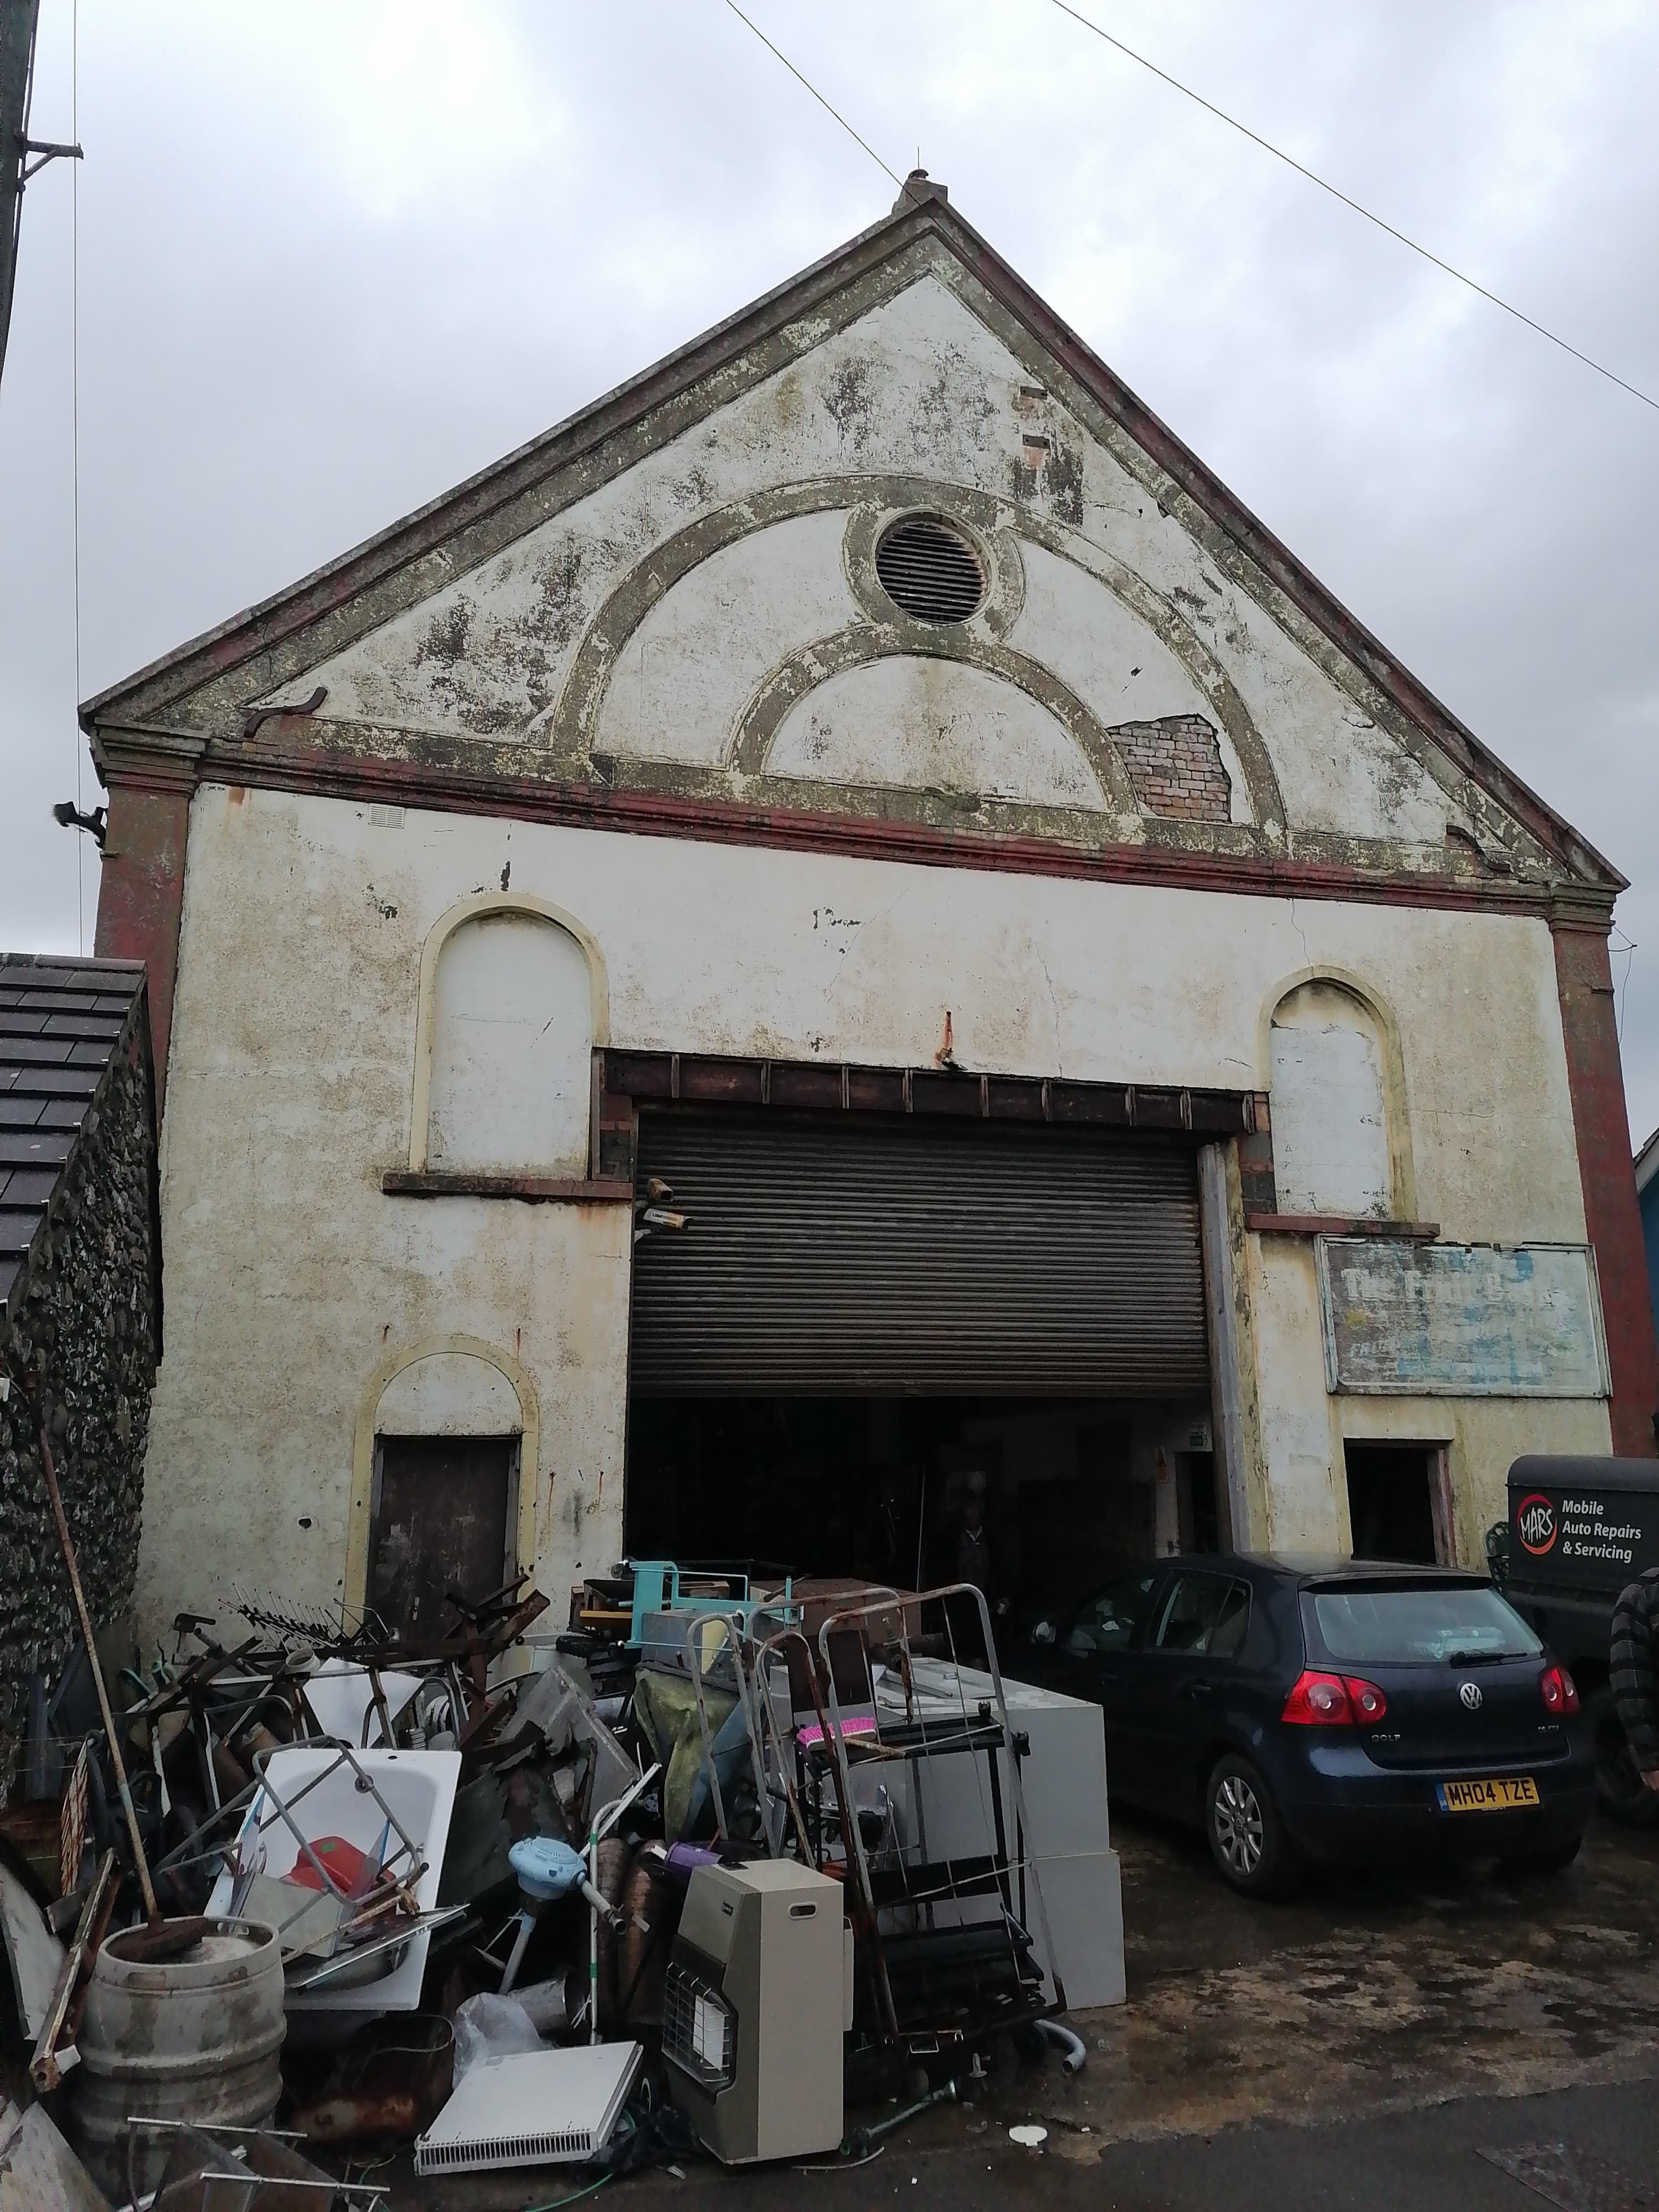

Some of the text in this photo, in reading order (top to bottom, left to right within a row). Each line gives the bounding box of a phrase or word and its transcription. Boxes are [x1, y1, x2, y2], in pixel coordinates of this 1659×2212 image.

[1562, 1500, 1604, 1515] Mobile
[1520, 1507, 1553, 1543] MARS
[1562, 1521, 1641, 1540] Auto Repairs
[1562, 1541, 1632, 1563] & Servicing
[1448, 1780, 1534, 1806] MH04 TZE
